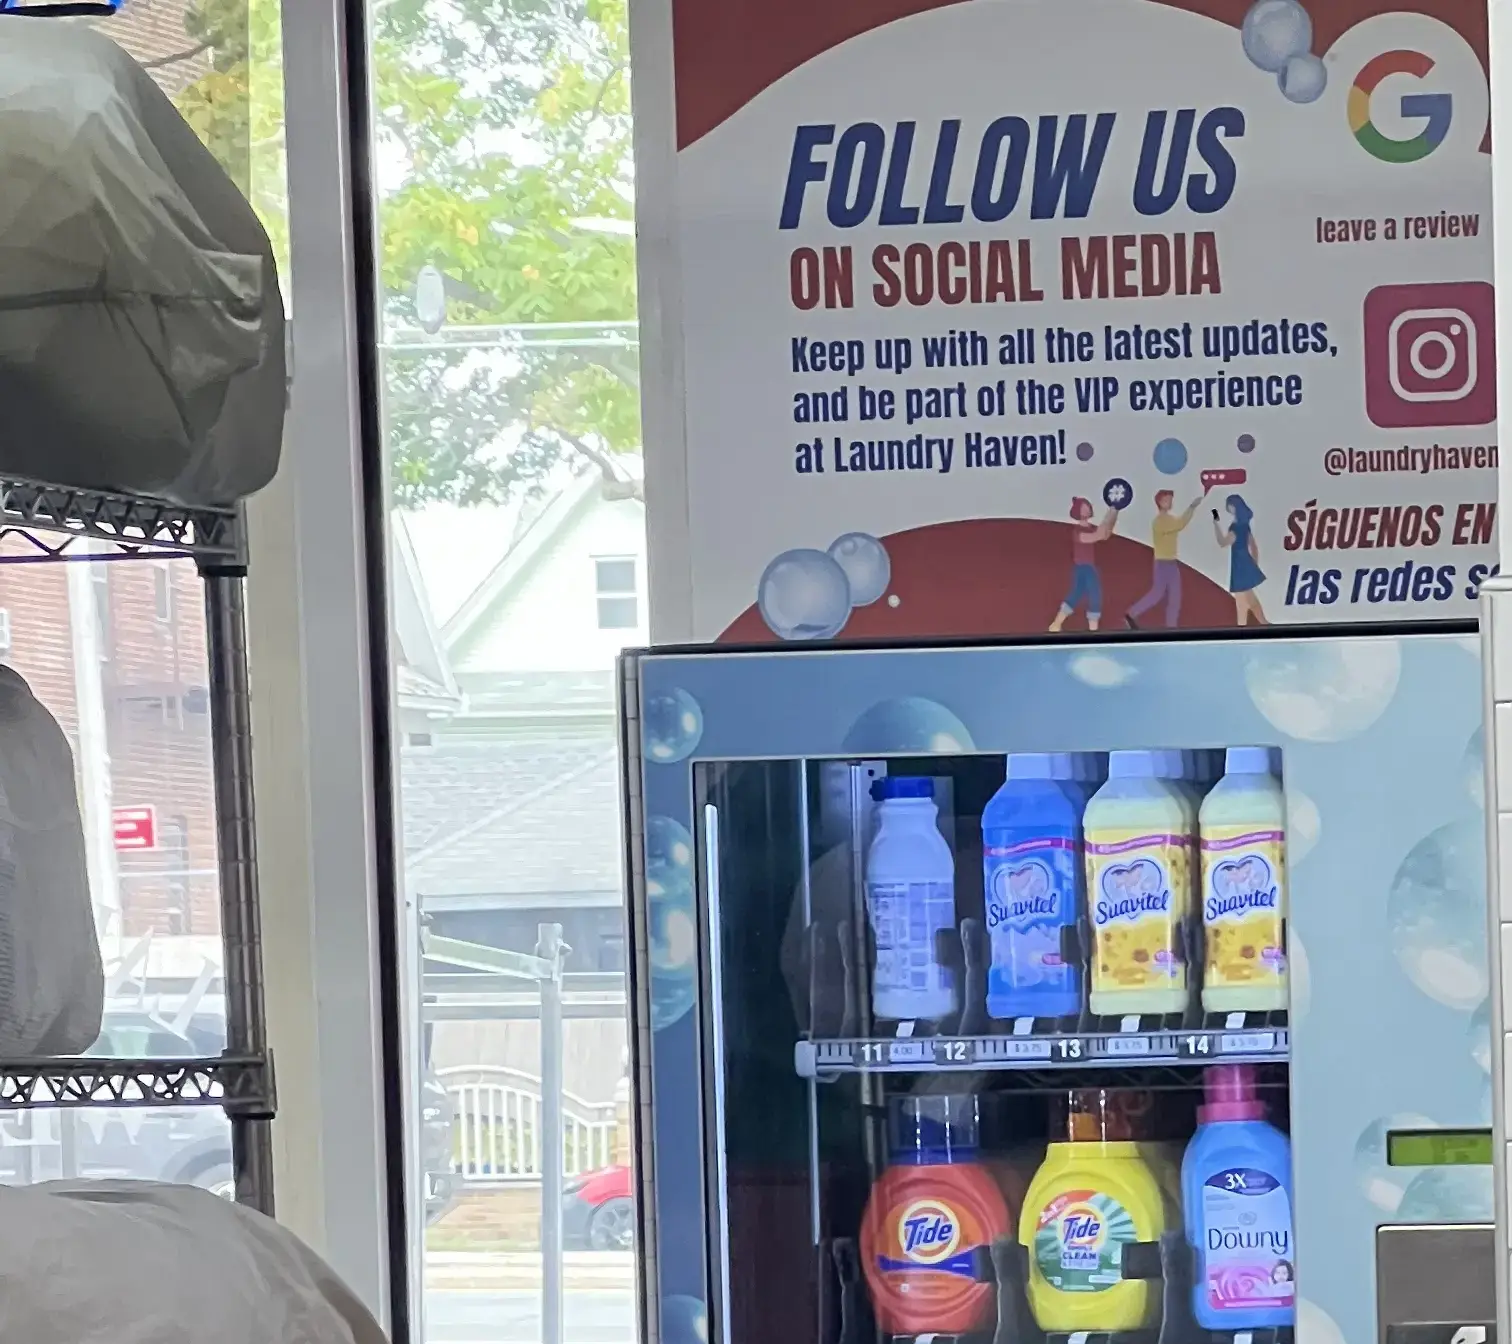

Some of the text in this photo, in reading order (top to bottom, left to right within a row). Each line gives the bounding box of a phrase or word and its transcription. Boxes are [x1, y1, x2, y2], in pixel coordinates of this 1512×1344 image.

[779, 106, 1246, 230] FOLLOW US
[1316, 211, 1479, 244] leave a review
[789, 231, 1222, 310] ON SOCIAL MEDIA
[791, 318, 1337, 377] Keep up with all the latest updates,
[793, 370, 1302, 425] and be part of the VIP experience
[795, 429, 1066, 473] at Laundry Haven!
[1283, 498, 1497, 552] SÍGUENOS EN
[1284, 564, 1342, 606] las
[1351, 560, 1454, 603] redes
[1096, 889, 1169, 924] Suavitel
[1206, 886, 1276, 921] Suavitel
[861, 1044, 882, 1061] 11
[943, 1042, 966, 1060] 12
[1058, 1040, 1081, 1059] 13
[1187, 1036, 1208, 1055] 14
[1225, 1173, 1247, 1190] 3X
[904, 1217, 952, 1251] Tide
[1064, 1217, 1100, 1244] Tide
[1208, 1228, 1288, 1255] Downy
